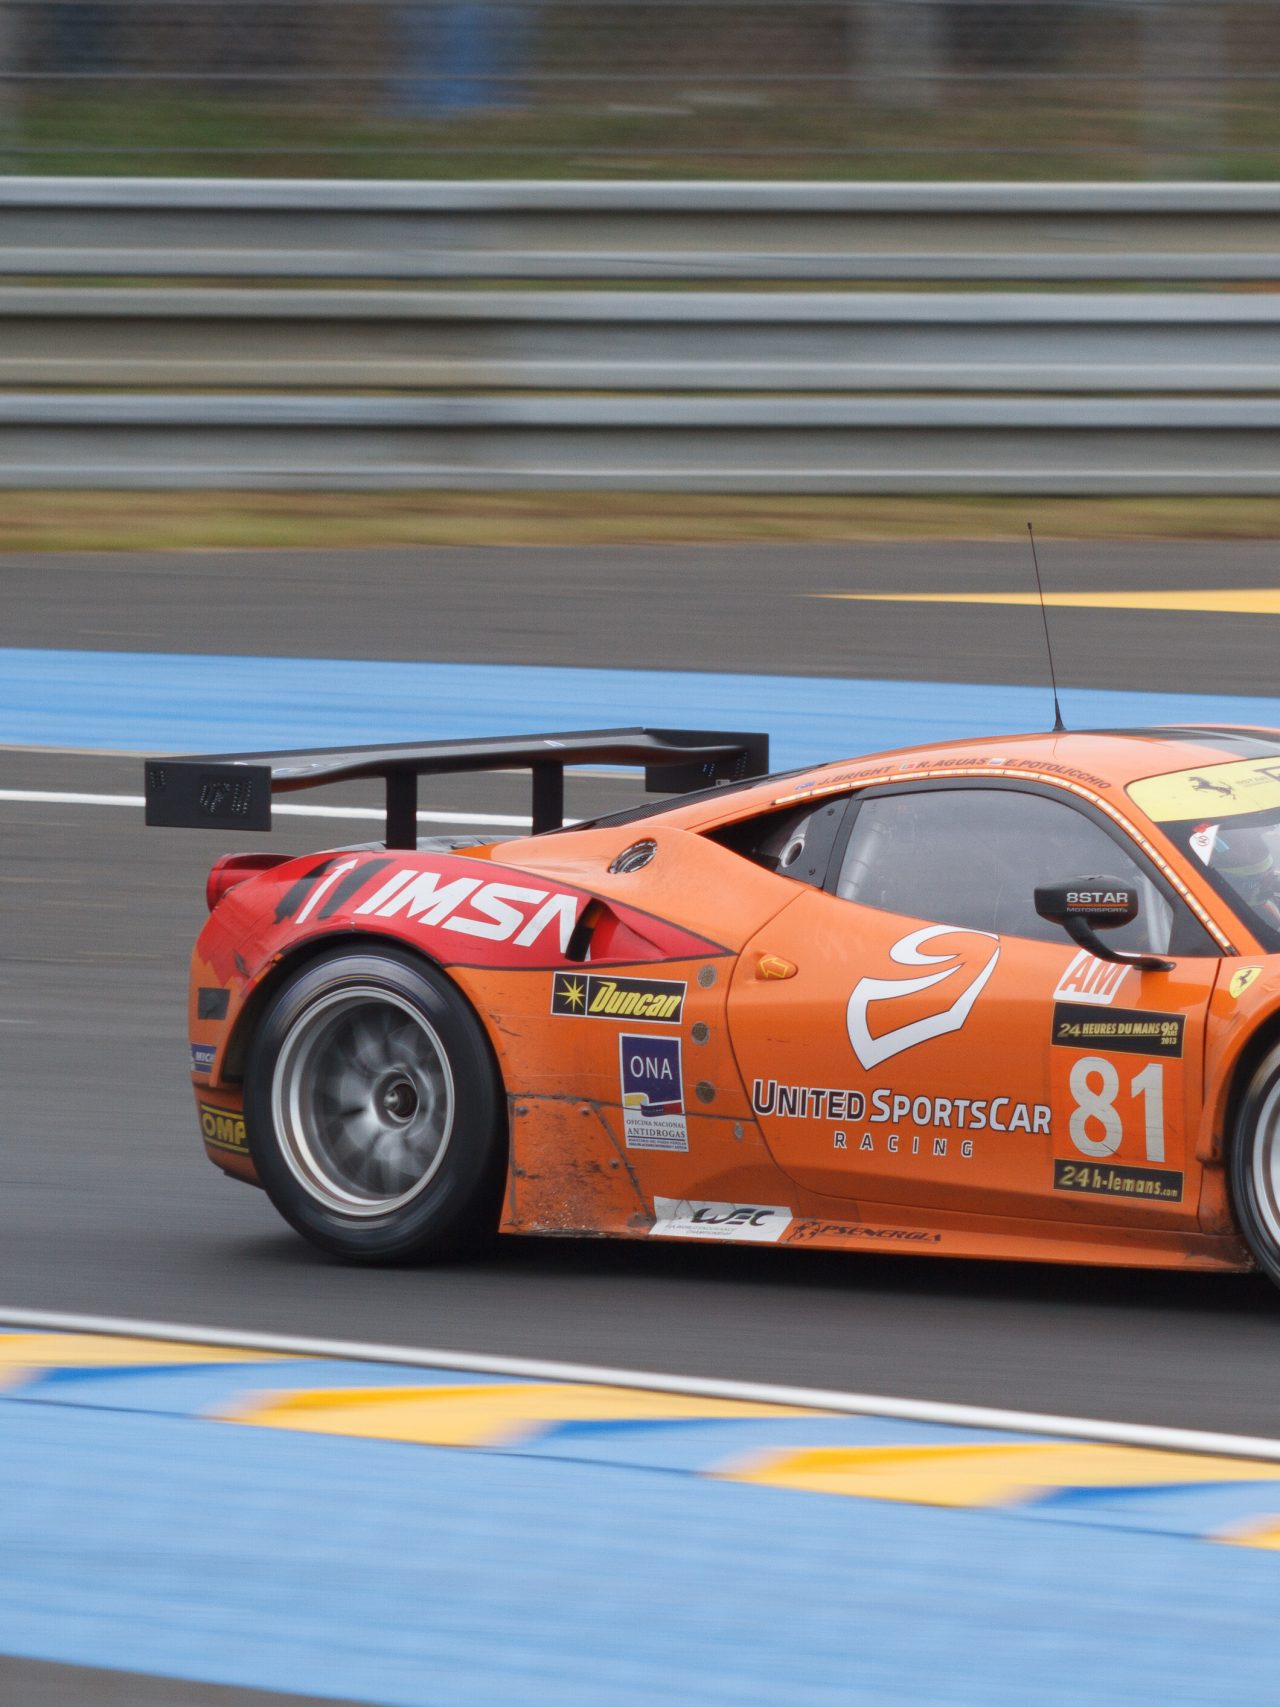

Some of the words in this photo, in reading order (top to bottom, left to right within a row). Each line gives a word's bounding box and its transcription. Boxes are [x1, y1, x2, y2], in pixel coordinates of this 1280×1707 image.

[1066, 892, 1128, 903] 8STAR
[1059, 955, 1120, 995] AM
[589, 980, 682, 1018] Duncan
[1057, 1023, 1081, 1037] 24
[1082, 1022, 1116, 1035] HEURES
[1117, 1023, 1132, 1035] DU
[1132, 1023, 1161, 1035] MANS
[630, 1055, 673, 1080] ONA
[1069, 1056, 1165, 1162] 81
[202, 1112, 247, 1145] OMP
[627, 1127, 686, 1139] ANTIDROGAS
[653, 1121, 686, 1129] NACIONAL
[833, 1131, 974, 1158] RACING
[691, 1207, 776, 1227] WEC
